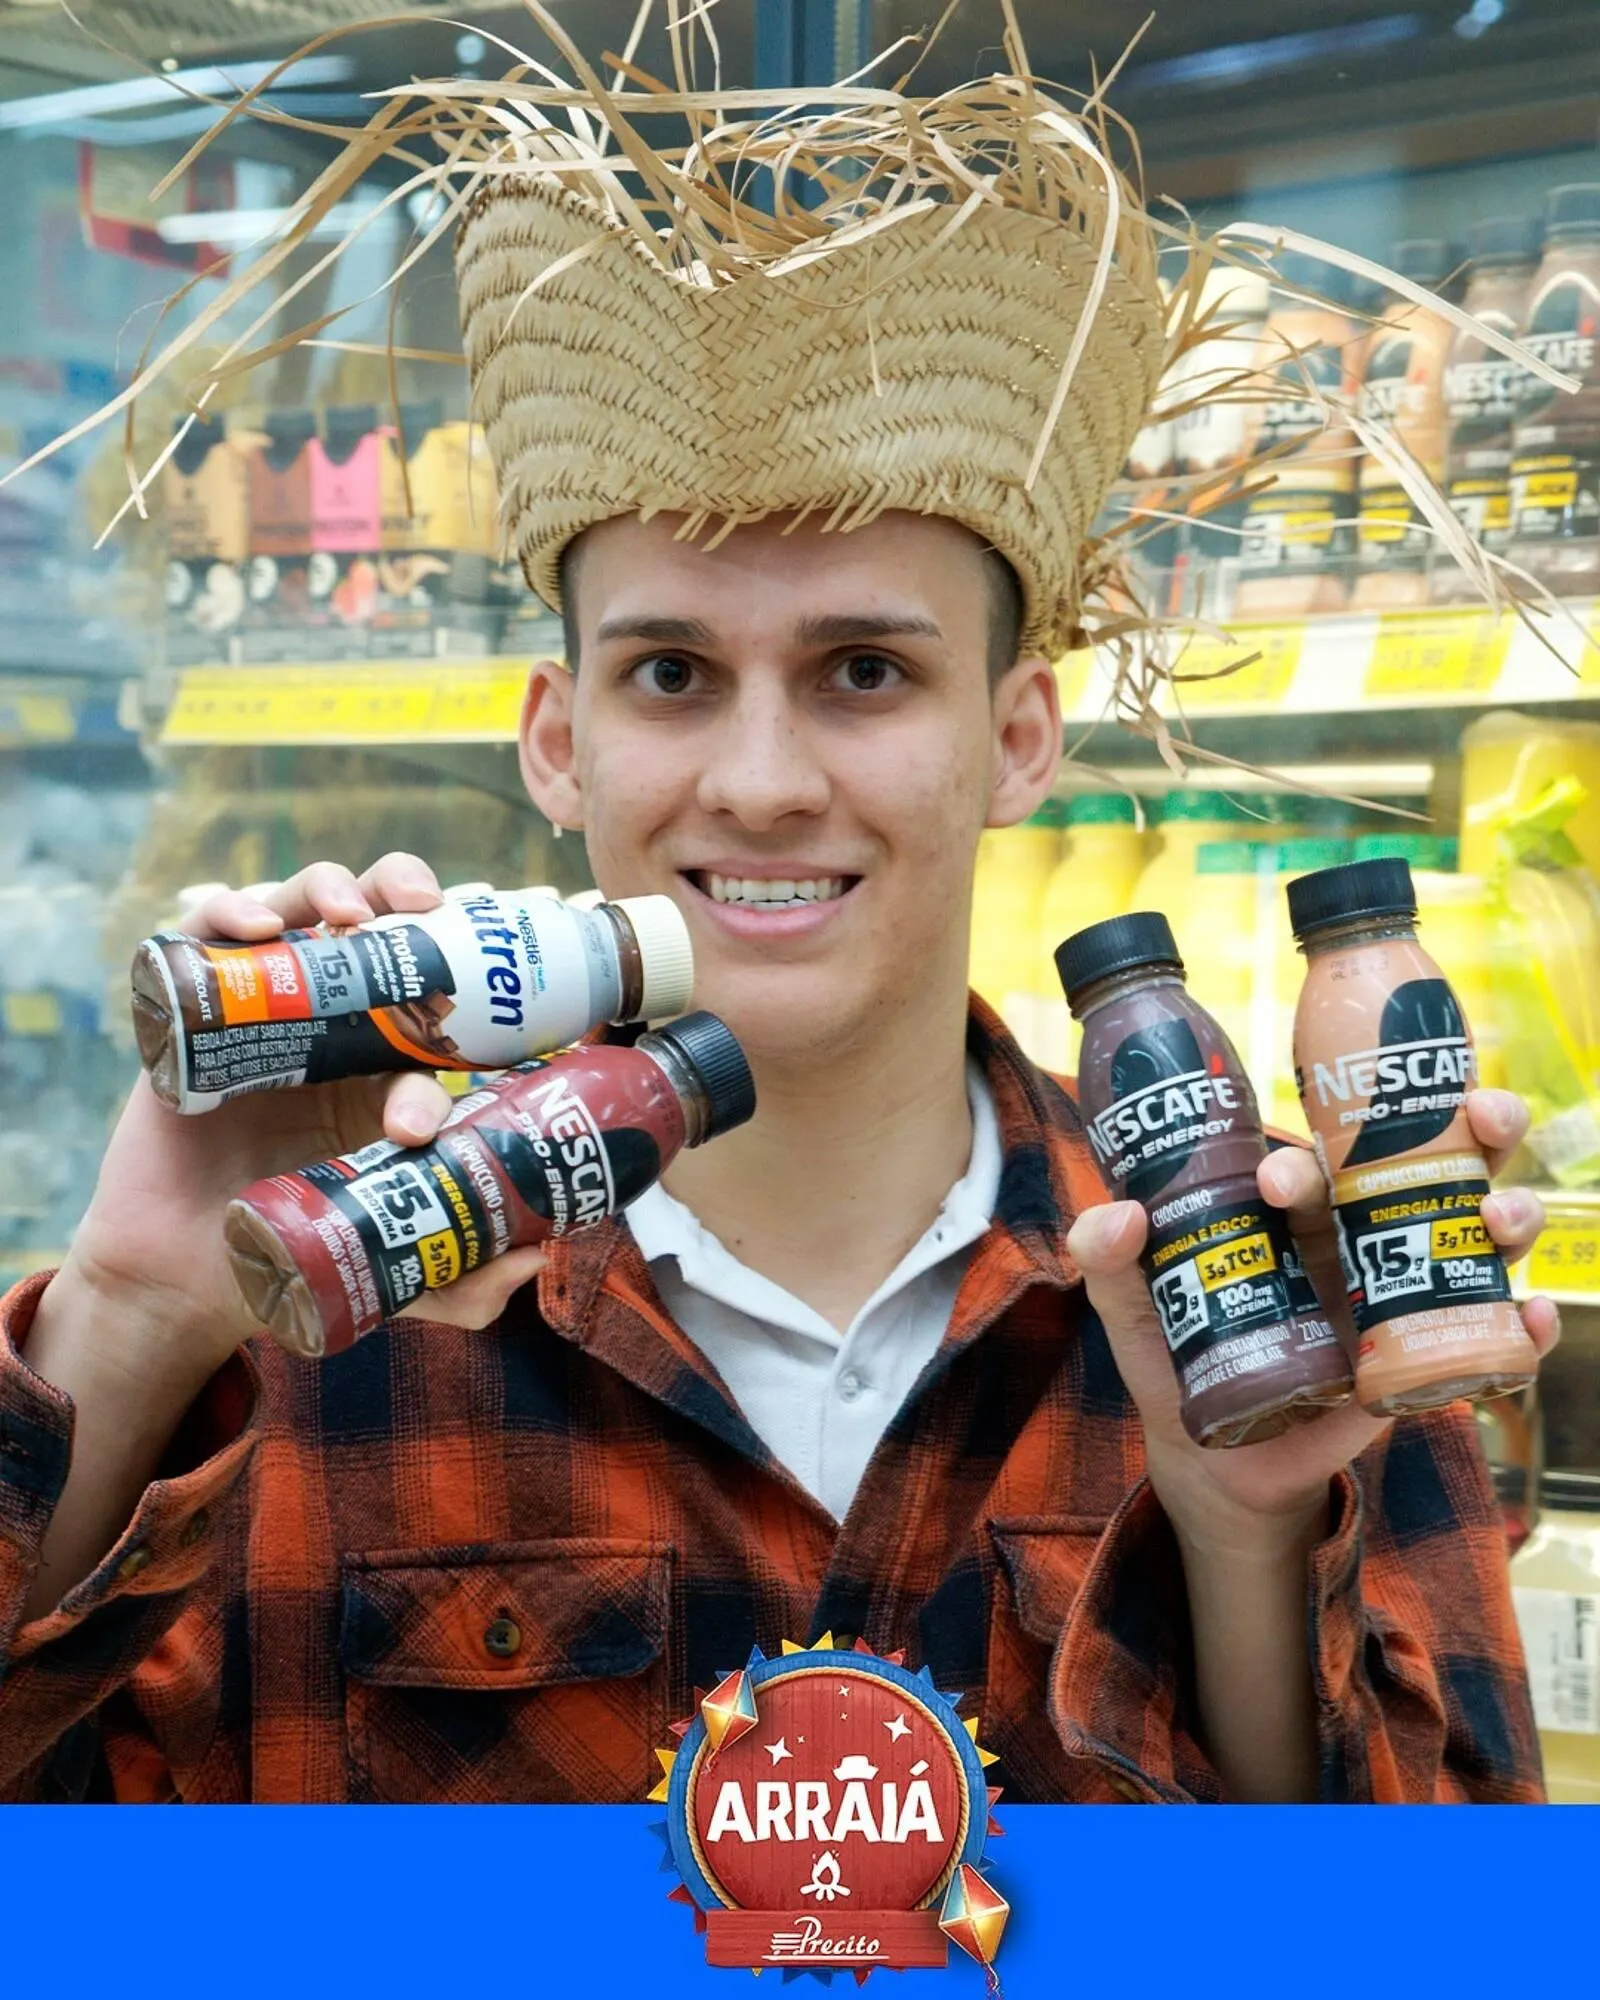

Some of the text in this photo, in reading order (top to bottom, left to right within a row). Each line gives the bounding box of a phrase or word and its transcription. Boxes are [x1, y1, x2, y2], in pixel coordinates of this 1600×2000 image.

[276, 953, 299, 996] ZERO
[320, 950, 352, 999] 15 g
[386, 927, 426, 998] Protein
[455, 895, 525, 1028] nutren
[190, 958, 213, 1022] CHOCOLATE
[192, 1020, 328, 1050] BEBIDA LÁCTEA UHT SABOR CHOCOLATE
[194, 1037, 313, 1069] PARA DIETAS COM RESTRIÇÃO DE
[230, 1060, 263, 1080] FRUTOSE
[262, 1059, 268, 1072] E
[268, 1053, 308, 1071] SACAROSE
[1313, 1036, 1478, 1107] NESCAF
[1339, 1091, 1467, 1127] PRO-ENER
[527, 1076, 615, 1230] NESCAF
[1111, 1117, 1235, 1180] PRO-ENERGY
[451, 1134, 505, 1209] CAPPUCCINO
[1356, 1161, 1441, 1194] CAPPUCCINO
[358, 1187, 399, 1242] PROTEÍNA
[431, 1163, 475, 1228] ENERGIA
[464, 1226, 478, 1241] E
[1152, 1188, 1214, 1228] CHOCOCINO
[1369, 1193, 1486, 1224] ENERGIA E FOC
[326, 1208, 369, 1269] SUPLEMENTO
[1152, 1234, 1198, 1267] ENERGIA
[1197, 1227, 1209, 1241] E
[1224, 1242, 1268, 1271] TCM
[1373, 1275, 1426, 1296] PROTEÍNA
[1449, 1275, 1493, 1290] CAFEÍNA
[1226, 1295, 1276, 1320] CAFEÍNA
[1437, 1324, 1466, 1344] SABOR
[1224, 1364, 1233, 1379] E
[1233, 1345, 1288, 1376] CHOCOLATE
